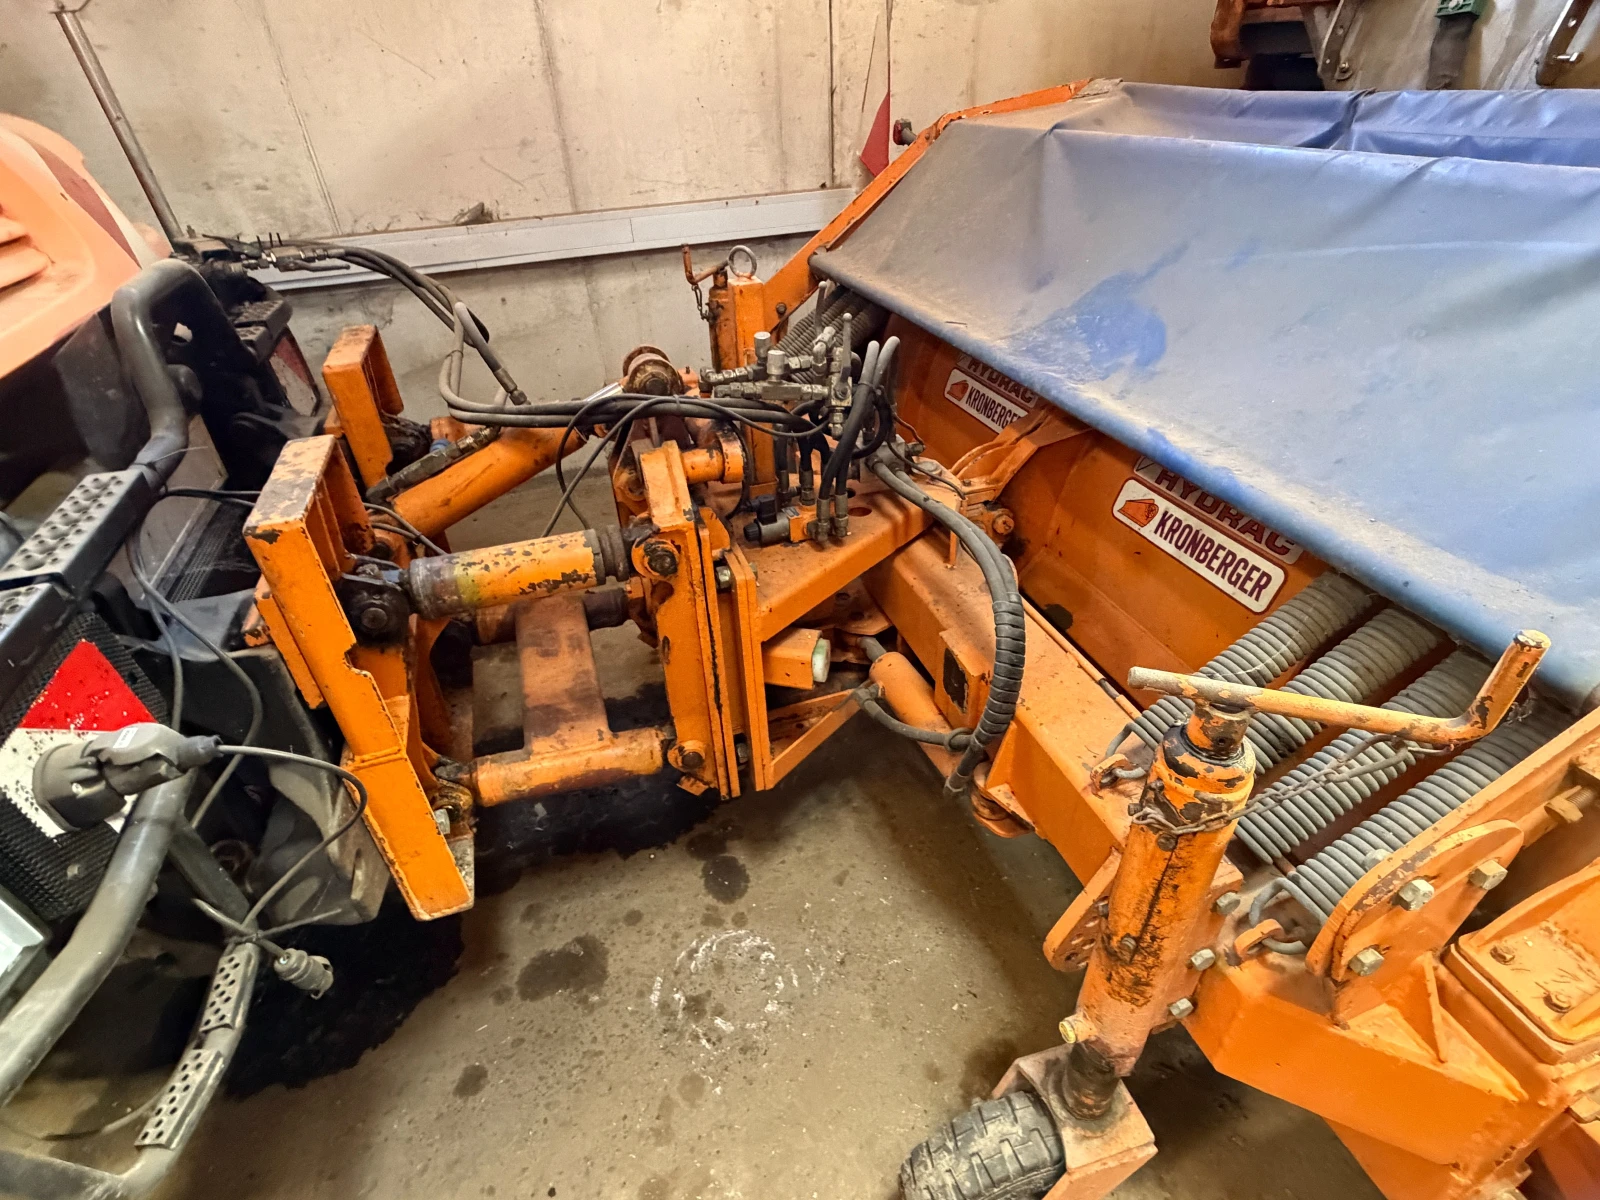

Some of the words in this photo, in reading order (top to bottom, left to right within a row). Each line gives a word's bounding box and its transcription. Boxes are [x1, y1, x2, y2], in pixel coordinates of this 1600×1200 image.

[966, 386, 1021, 429] KRONBERGE
[968, 359, 1034, 403] HYDRAC
[1155, 469, 1295, 556] HYDRAC
[1154, 510, 1273, 602] KRONBERGER
